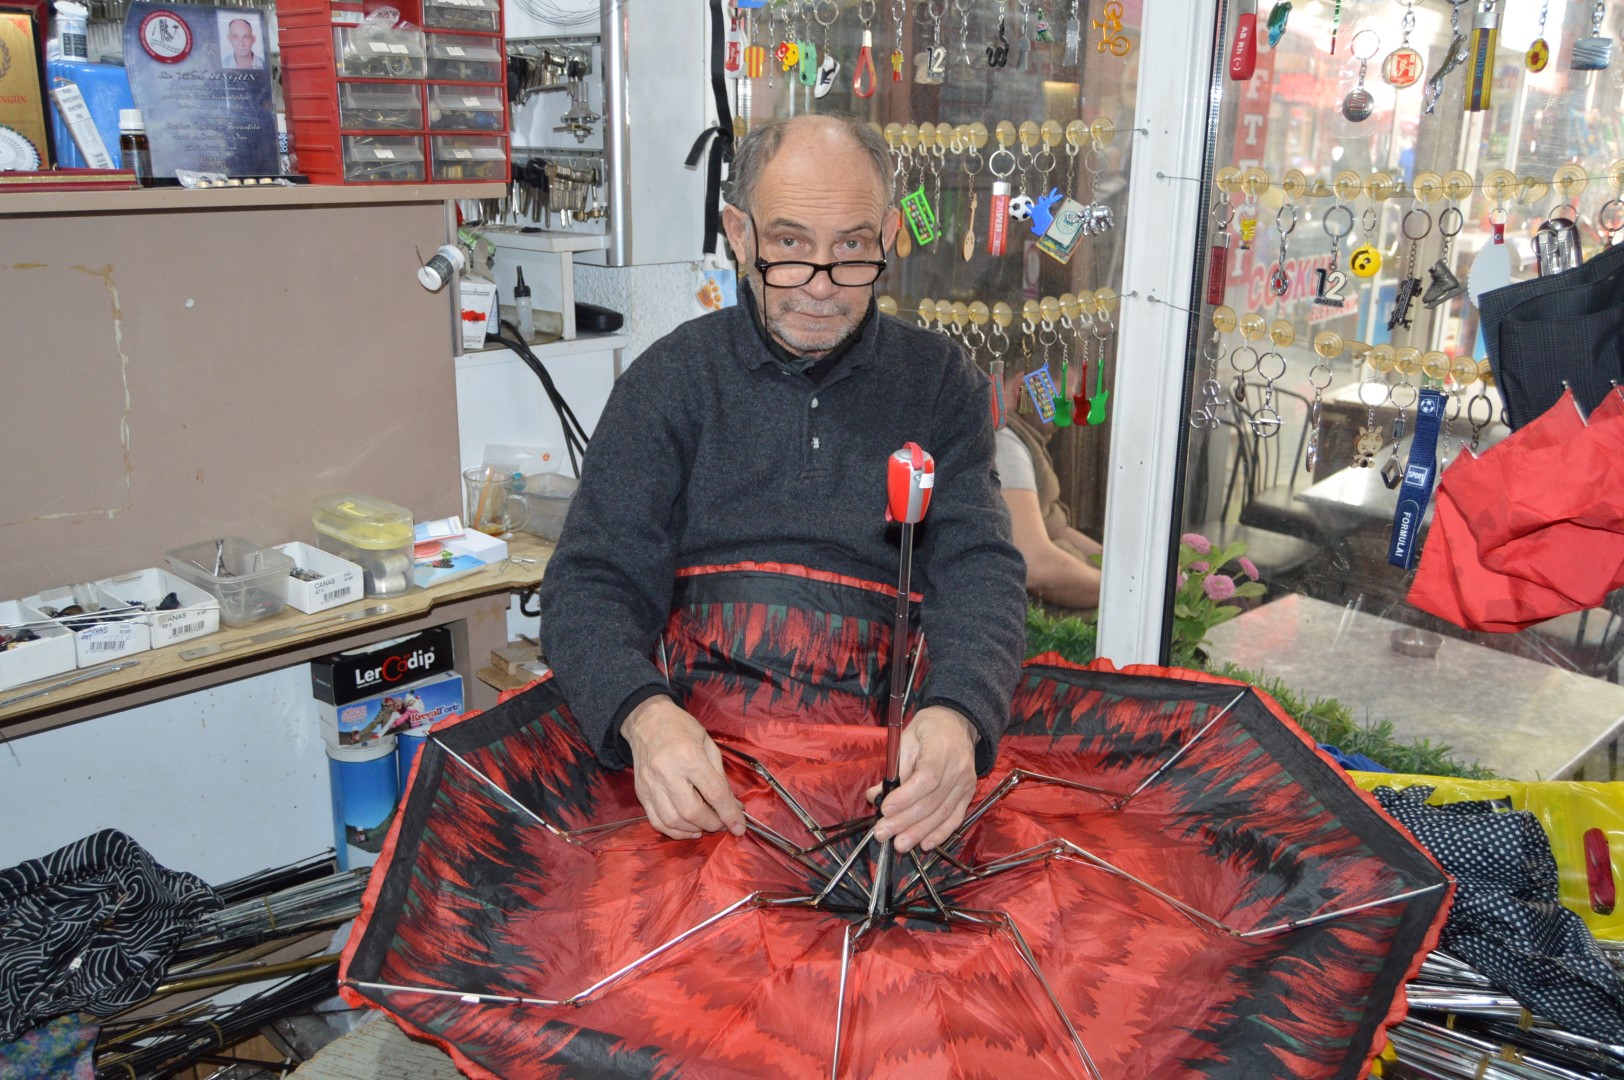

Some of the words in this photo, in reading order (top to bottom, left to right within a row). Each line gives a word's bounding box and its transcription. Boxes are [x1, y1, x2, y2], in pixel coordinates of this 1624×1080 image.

[1239, 26, 1248, 39] AB
[926, 46, 947, 73] 12
[1475, 38, 1488, 77] PEUGEOT
[1315, 267, 1346, 301] 12
[314, 579, 336, 589] CANAS
